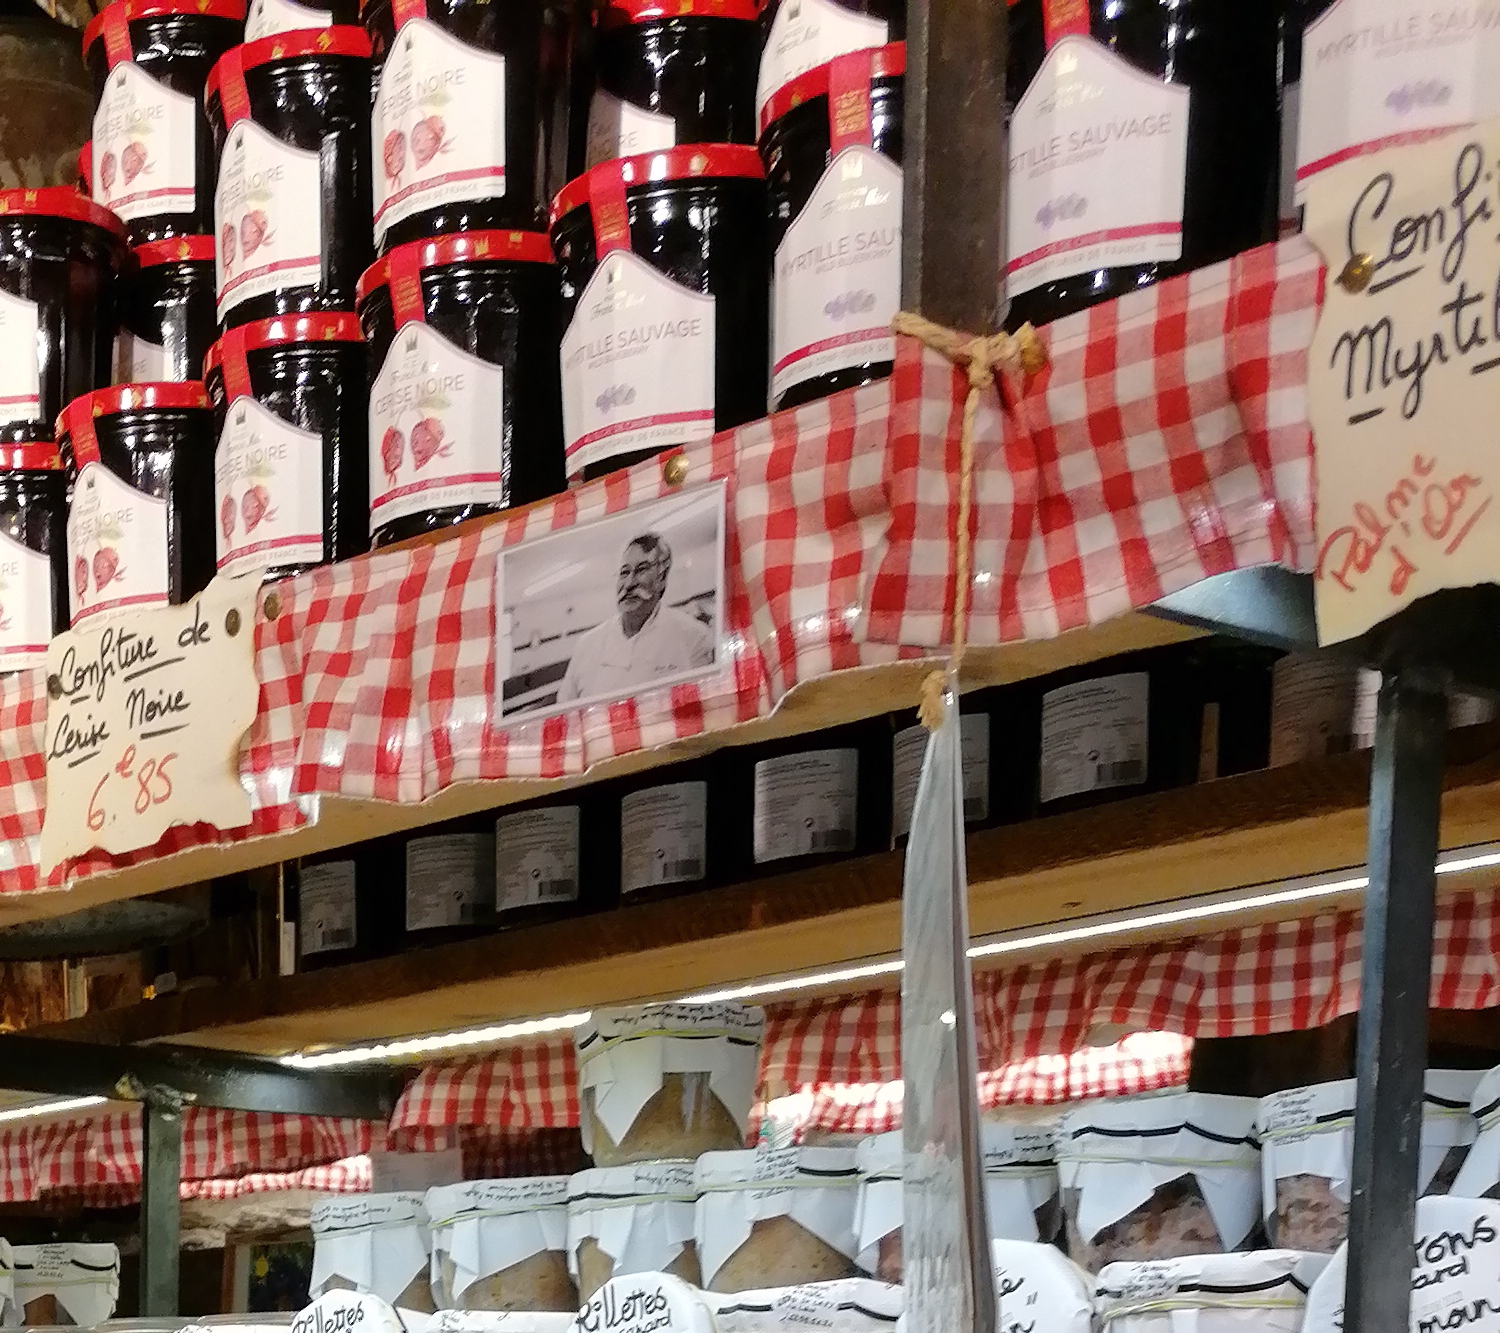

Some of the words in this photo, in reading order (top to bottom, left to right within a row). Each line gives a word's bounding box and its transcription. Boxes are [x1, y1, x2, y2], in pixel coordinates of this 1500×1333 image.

[616, 316, 702, 351] SAUVAGE
[56, 626, 160, 701] Confiture
[177, 601, 212, 647] de
[49, 713, 110, 761] Cerise
[126, 687, 191, 730] Noire
